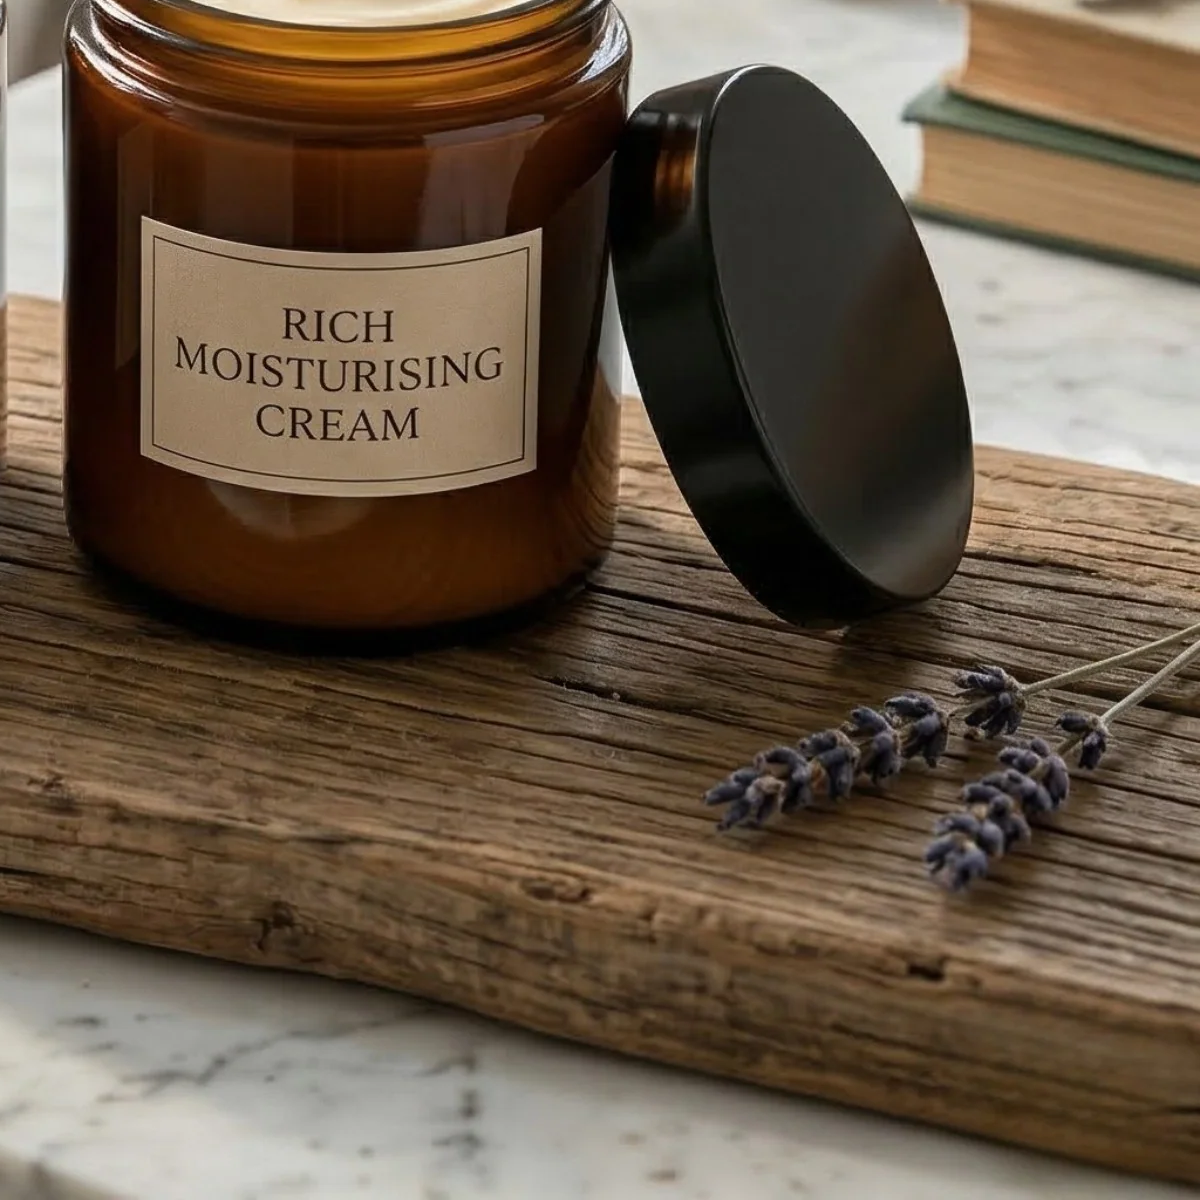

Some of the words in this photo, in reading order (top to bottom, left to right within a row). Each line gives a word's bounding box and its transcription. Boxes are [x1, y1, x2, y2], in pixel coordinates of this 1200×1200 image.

[282, 307, 394, 343] RICH
[175, 335, 504, 393] MOISTURISING
[256, 403, 420, 442] CREAM
